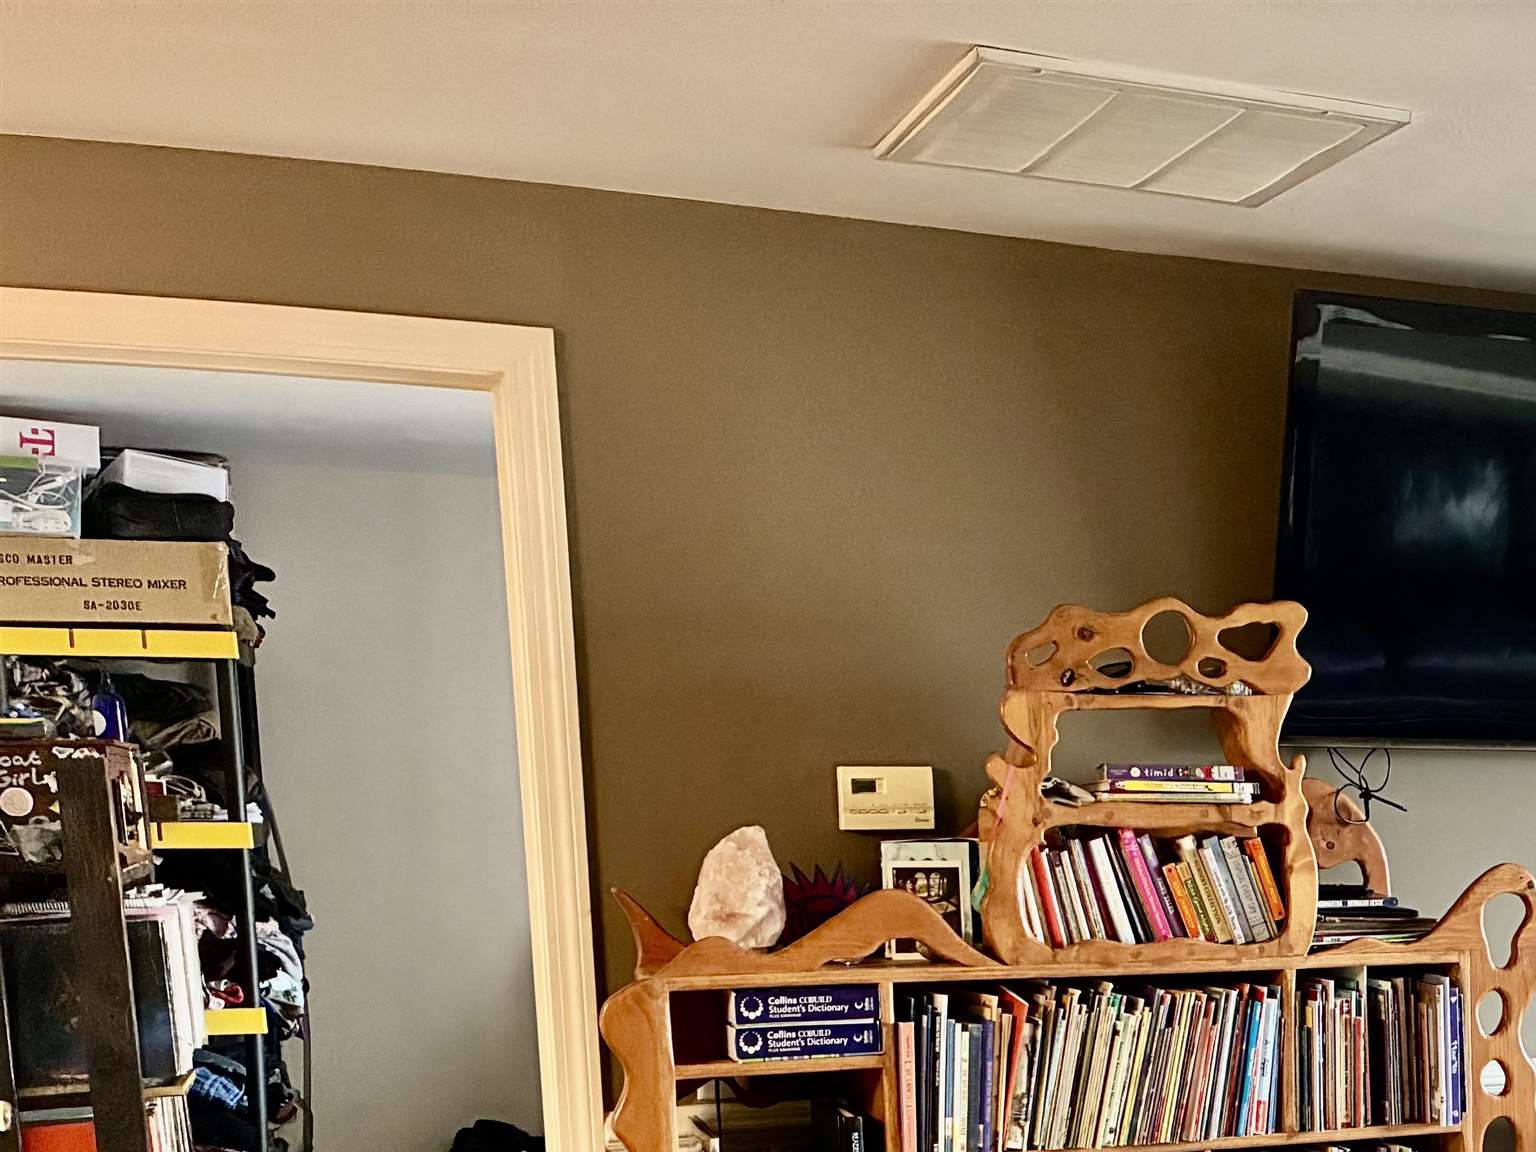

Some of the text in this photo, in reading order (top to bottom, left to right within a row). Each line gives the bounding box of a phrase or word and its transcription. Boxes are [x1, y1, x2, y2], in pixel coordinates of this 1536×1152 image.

[27, 554, 73, 565] MASTER
[91, 577, 143, 588] STEREO
[148, 579, 187, 590] MIXER
[1144, 767, 1174, 778] timid
[768, 996, 797, 1005] Collins
[768, 1003, 849, 1014] Student's Dictionary
[767, 1030, 797, 1039] Collins
[767, 1037, 848, 1048] Student's Dictionary
